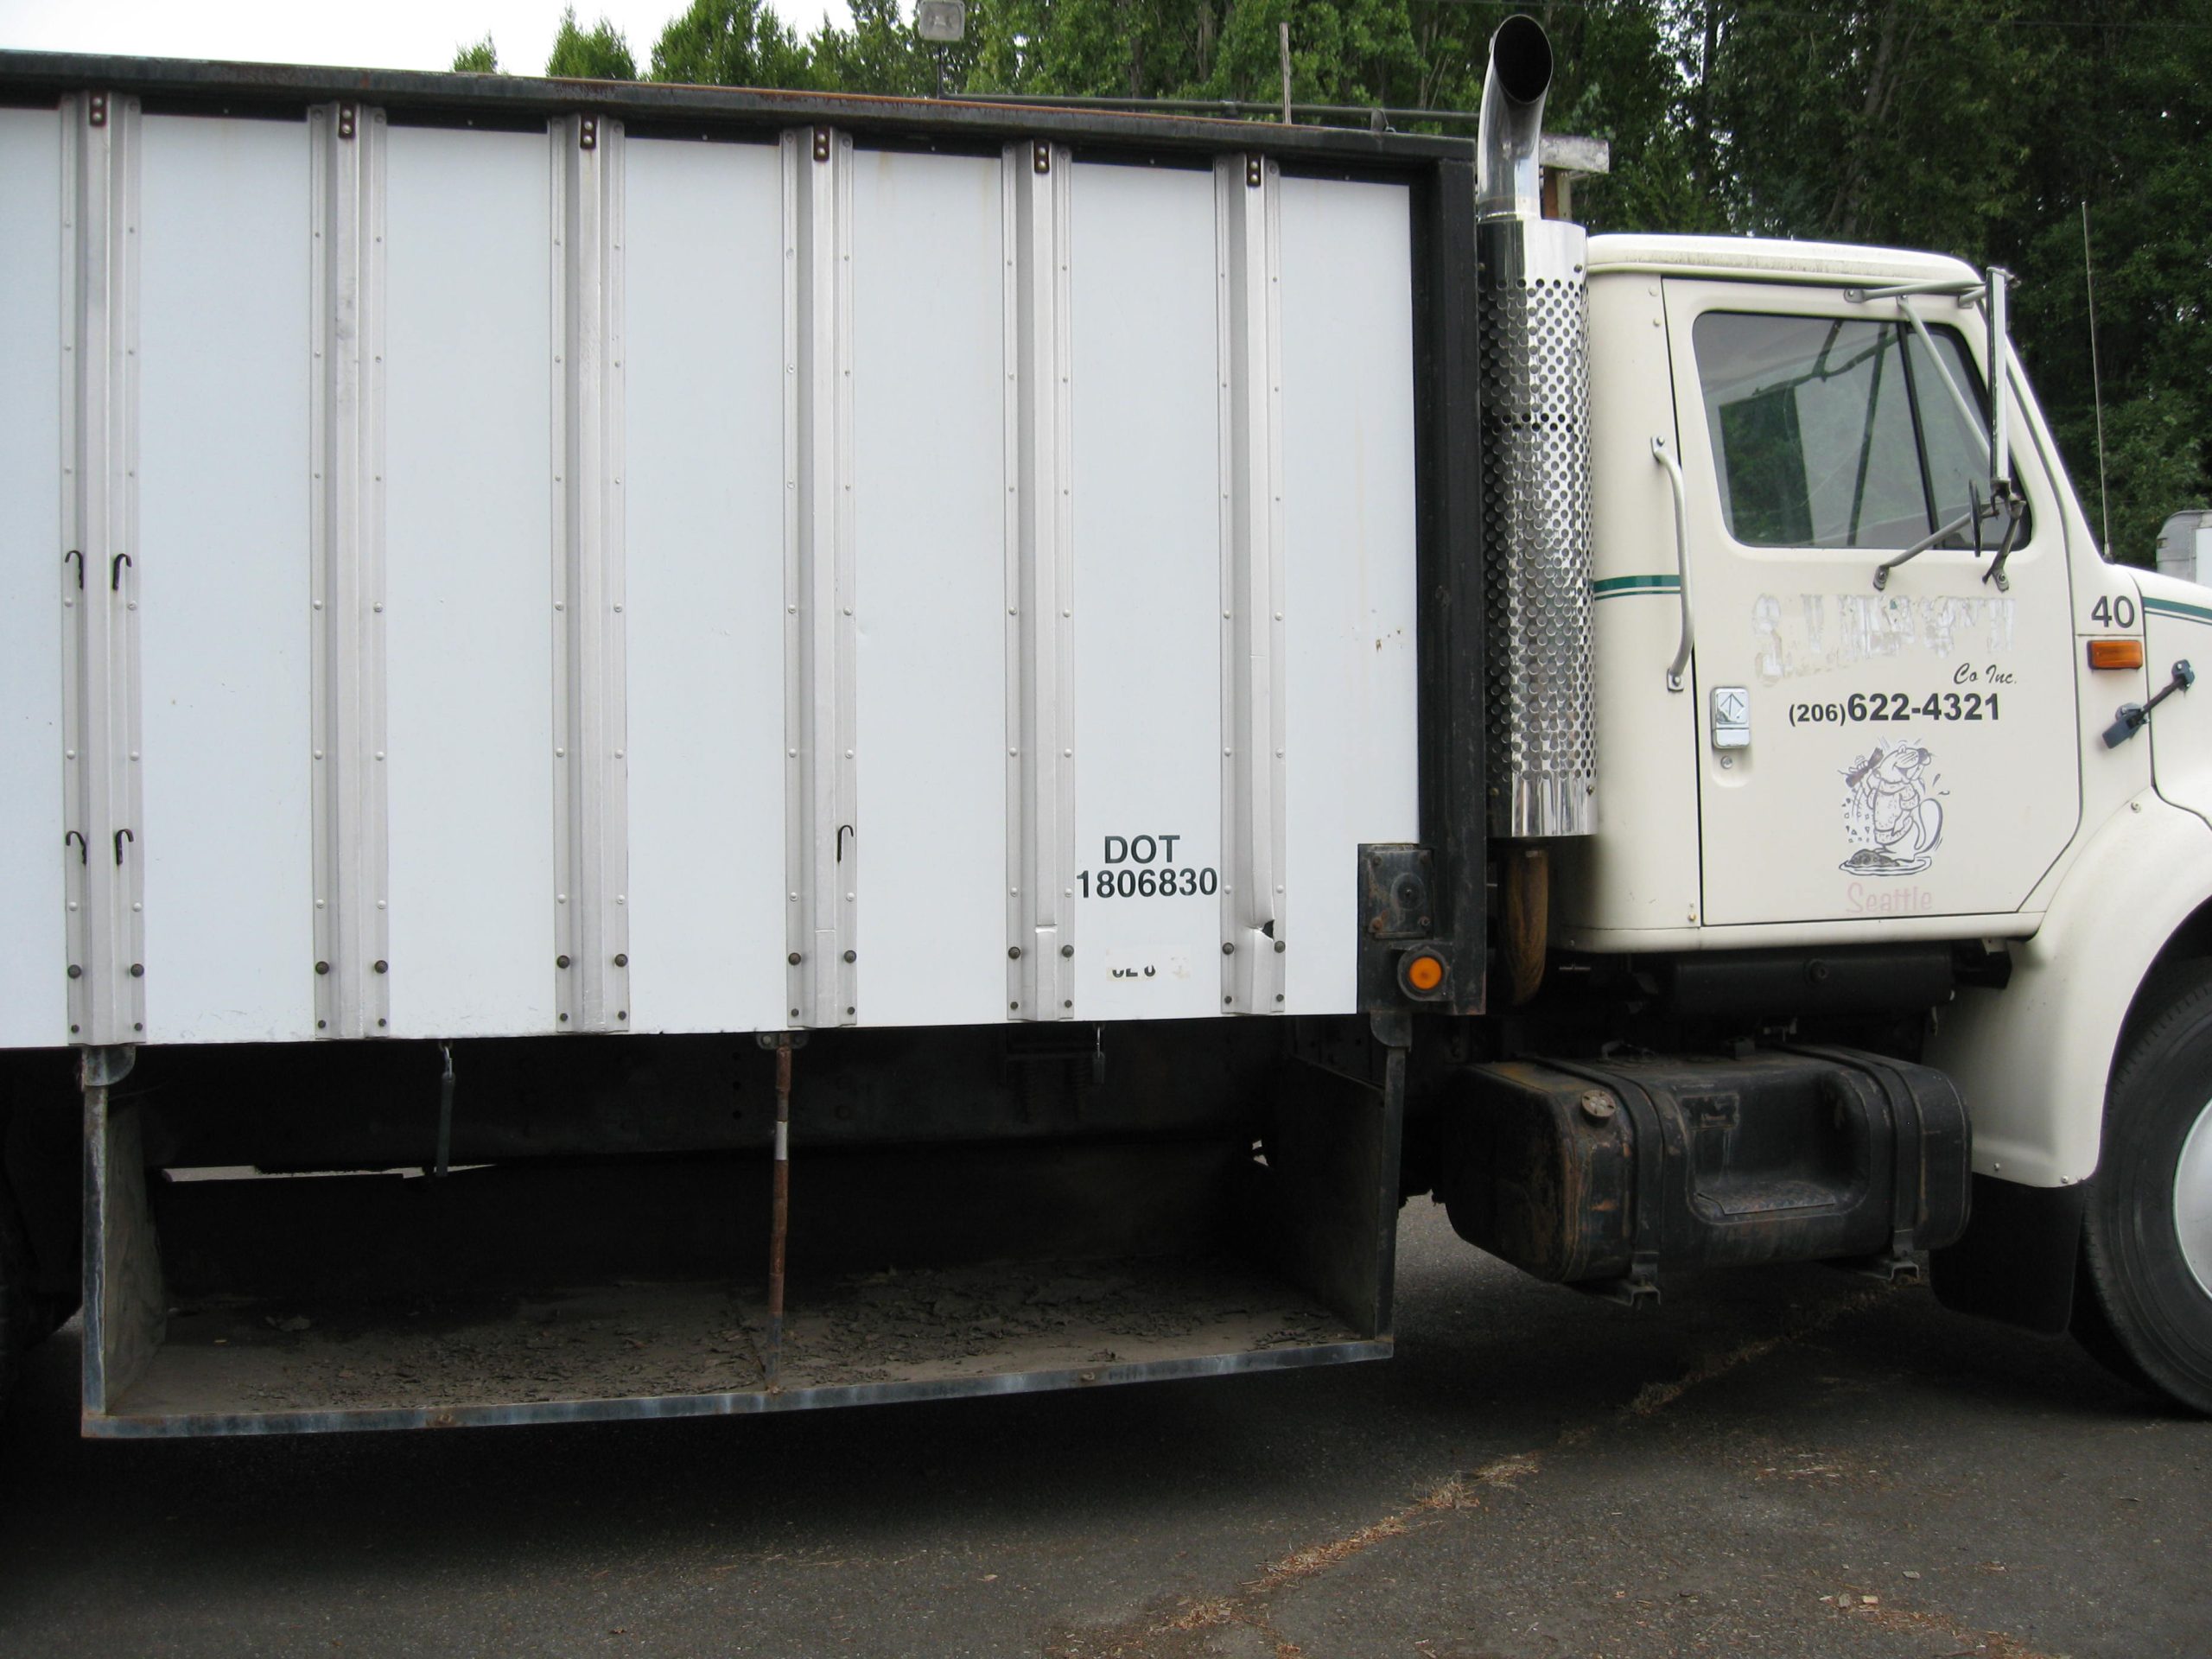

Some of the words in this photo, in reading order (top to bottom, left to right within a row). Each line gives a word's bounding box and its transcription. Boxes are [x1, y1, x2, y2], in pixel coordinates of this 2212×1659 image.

[2091, 595, 2135, 628] 40
[1953, 662, 1979, 685] Co
[1985, 664, 2018, 685] Inc.
[1104, 835, 1180, 864] DOT
[1077, 868, 1217, 899] 1806830
[1846, 881, 1933, 913] Seattle
